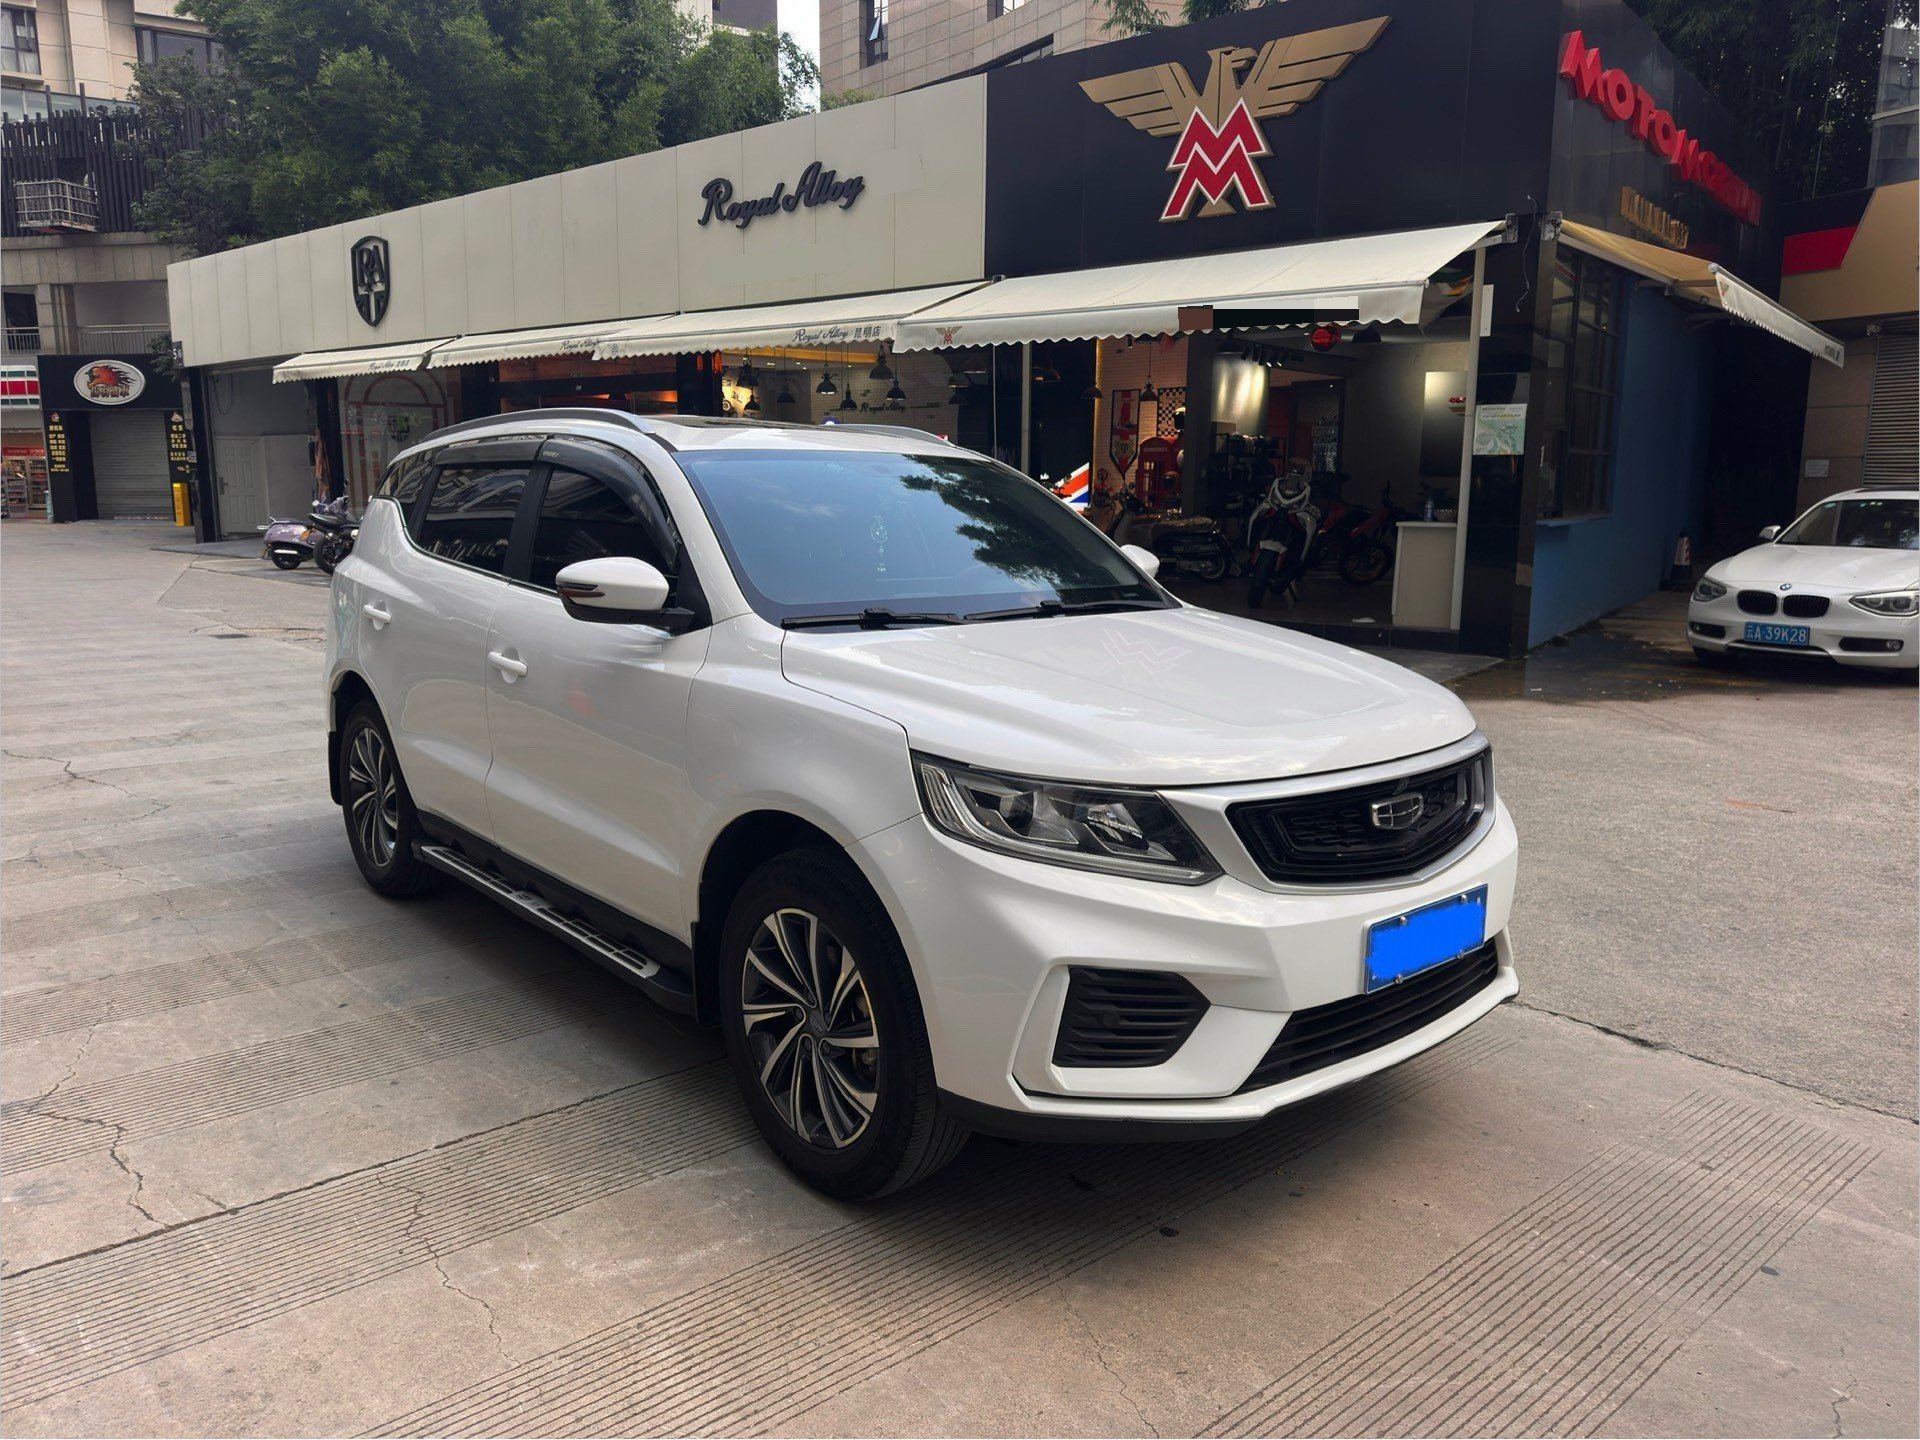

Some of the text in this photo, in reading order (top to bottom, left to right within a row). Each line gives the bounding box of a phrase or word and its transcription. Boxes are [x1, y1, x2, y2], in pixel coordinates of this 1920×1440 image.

[697, 161, 866, 229] Royal Alloy
[792, 325, 882, 343] Royal Alloy 昆明店
[560, 340, 579, 351] Royal
